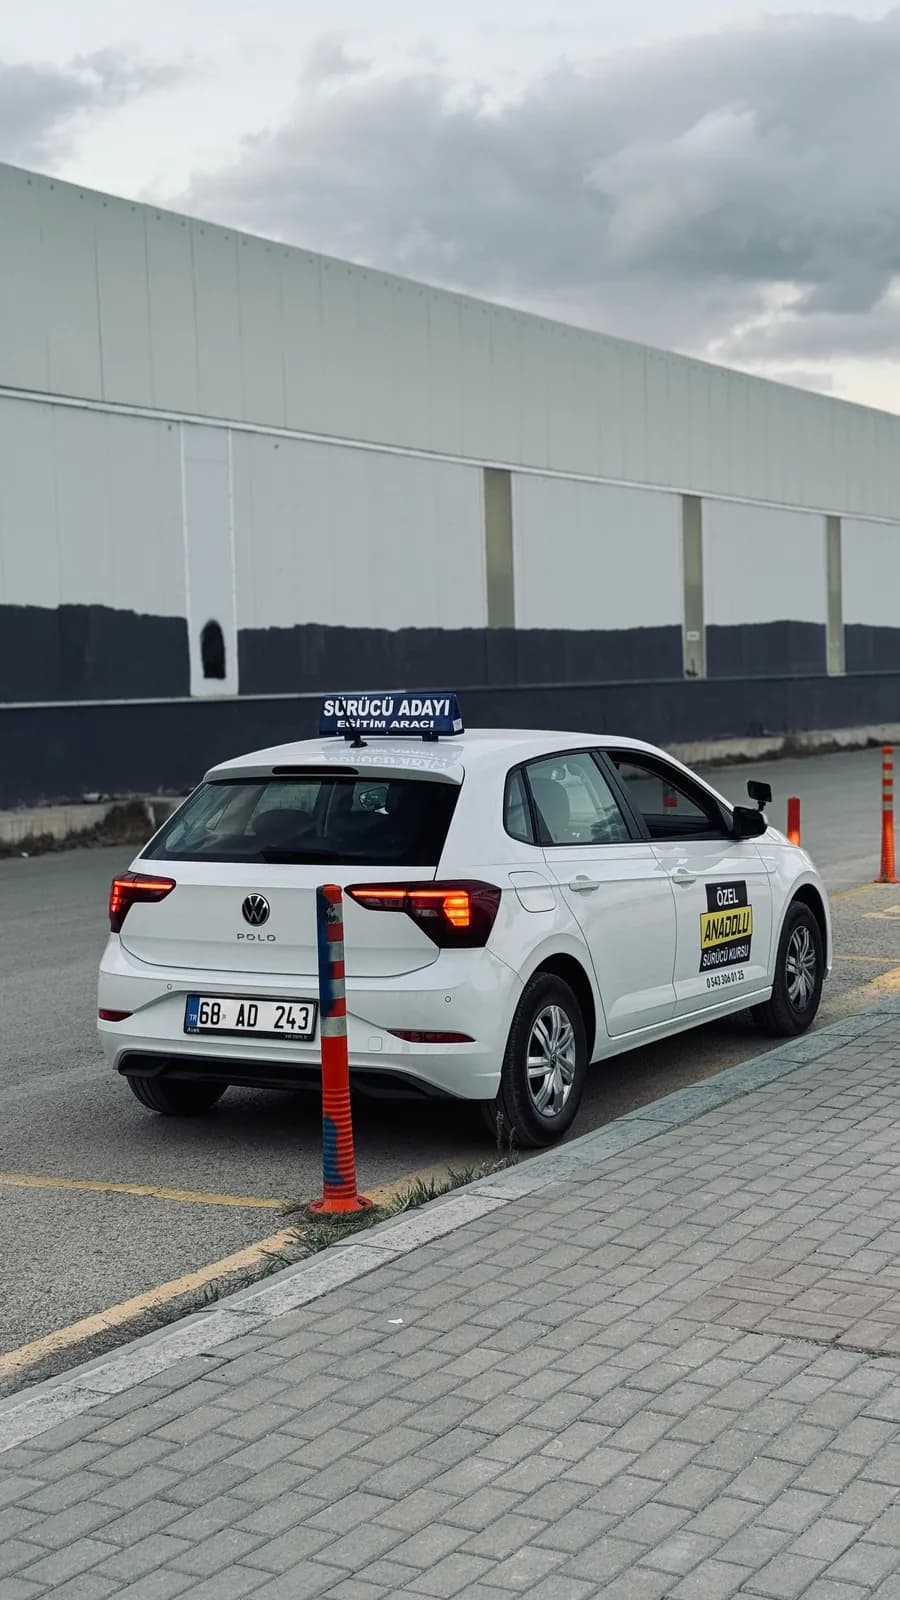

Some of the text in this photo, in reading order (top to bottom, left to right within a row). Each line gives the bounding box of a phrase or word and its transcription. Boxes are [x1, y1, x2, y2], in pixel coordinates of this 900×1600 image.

[323, 696, 450, 717] SÜRÜCÜ ADAYI
[337, 718, 434, 728] EĞİTİM ARACI
[716, 886, 739, 906] ÖZEL
[704, 911, 750, 942] ANADOLU
[236, 933, 276, 942] POLO
[702, 943, 749, 967] SÜRÜCÜ KURSU
[706, 977, 711, 989] 0
[711, 975, 721, 987] 543
[731, 971, 737, 983] 01
[737, 969, 745, 981] 25
[189, 1013, 197, 1022] TR
[199, 1002, 309, 1031] 68 AD 243
